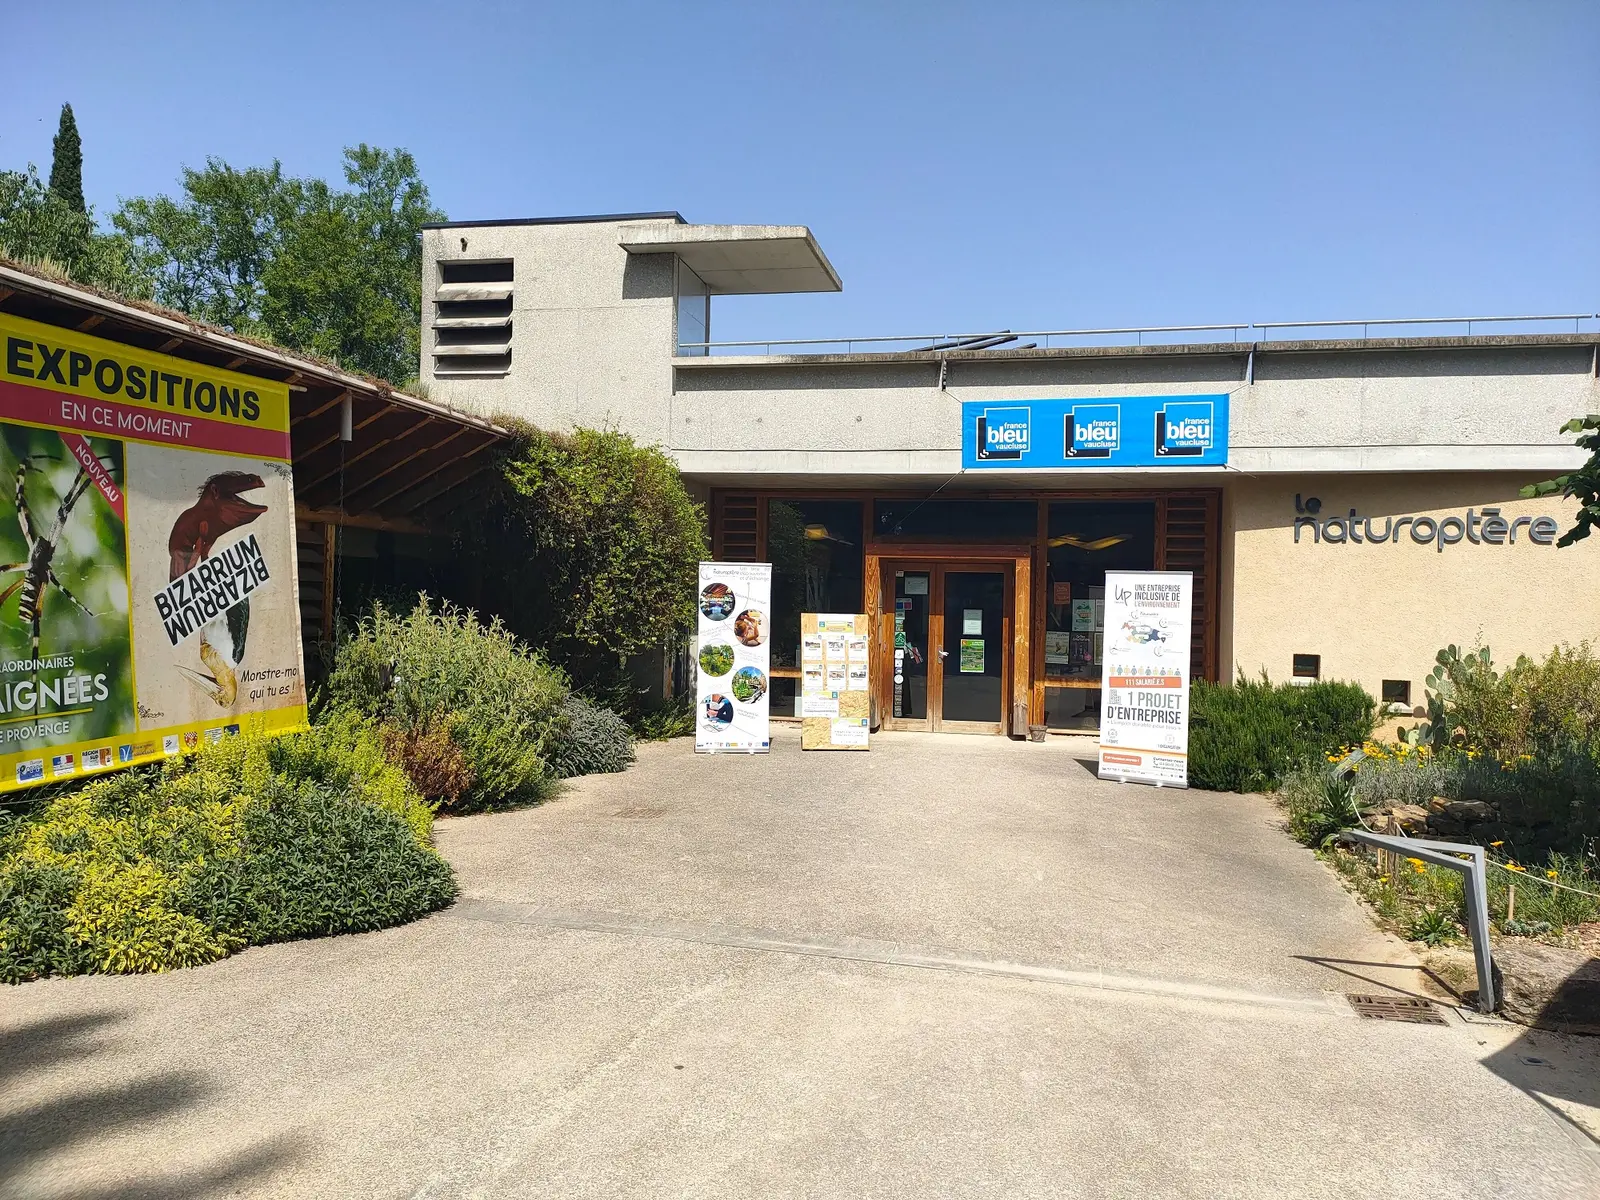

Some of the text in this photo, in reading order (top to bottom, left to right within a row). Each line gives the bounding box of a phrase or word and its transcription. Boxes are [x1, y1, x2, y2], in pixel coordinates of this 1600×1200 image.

[7, 336, 261, 421] EXPOSITIONS
[61, 400, 192, 439] EN CE MOMENT
[1092, 419, 1117, 427] france
[1184, 417, 1210, 425] france
[987, 426, 1028, 443] bleu
[1075, 424, 1117, 441] bleu
[1166, 421, 1210, 440] bleu
[995, 442, 1028, 450] vaucluse
[1083, 440, 1117, 448] vaucluse
[1175, 438, 1210, 446] vaucluse
[75, 443, 119, 503] NOUVEAU
[154, 533, 262, 621] BIZARRIUM
[1134, 591, 1180, 602] INCLUSIVE DE
[1147, 584, 1180, 593] ENTREPRISE
[163, 556, 270, 647] BIZARRIUM
[0, 656, 75, 673] AORDINAIRES
[250, 686, 264, 702] qui
[267, 686, 277, 697] tu
[279, 685, 290, 695] es
[1128, 691, 1182, 709] 1 PROJET
[1107, 706, 1181, 724] D'ENTREPRISE
[7, 721, 70, 742] PROVENCE
